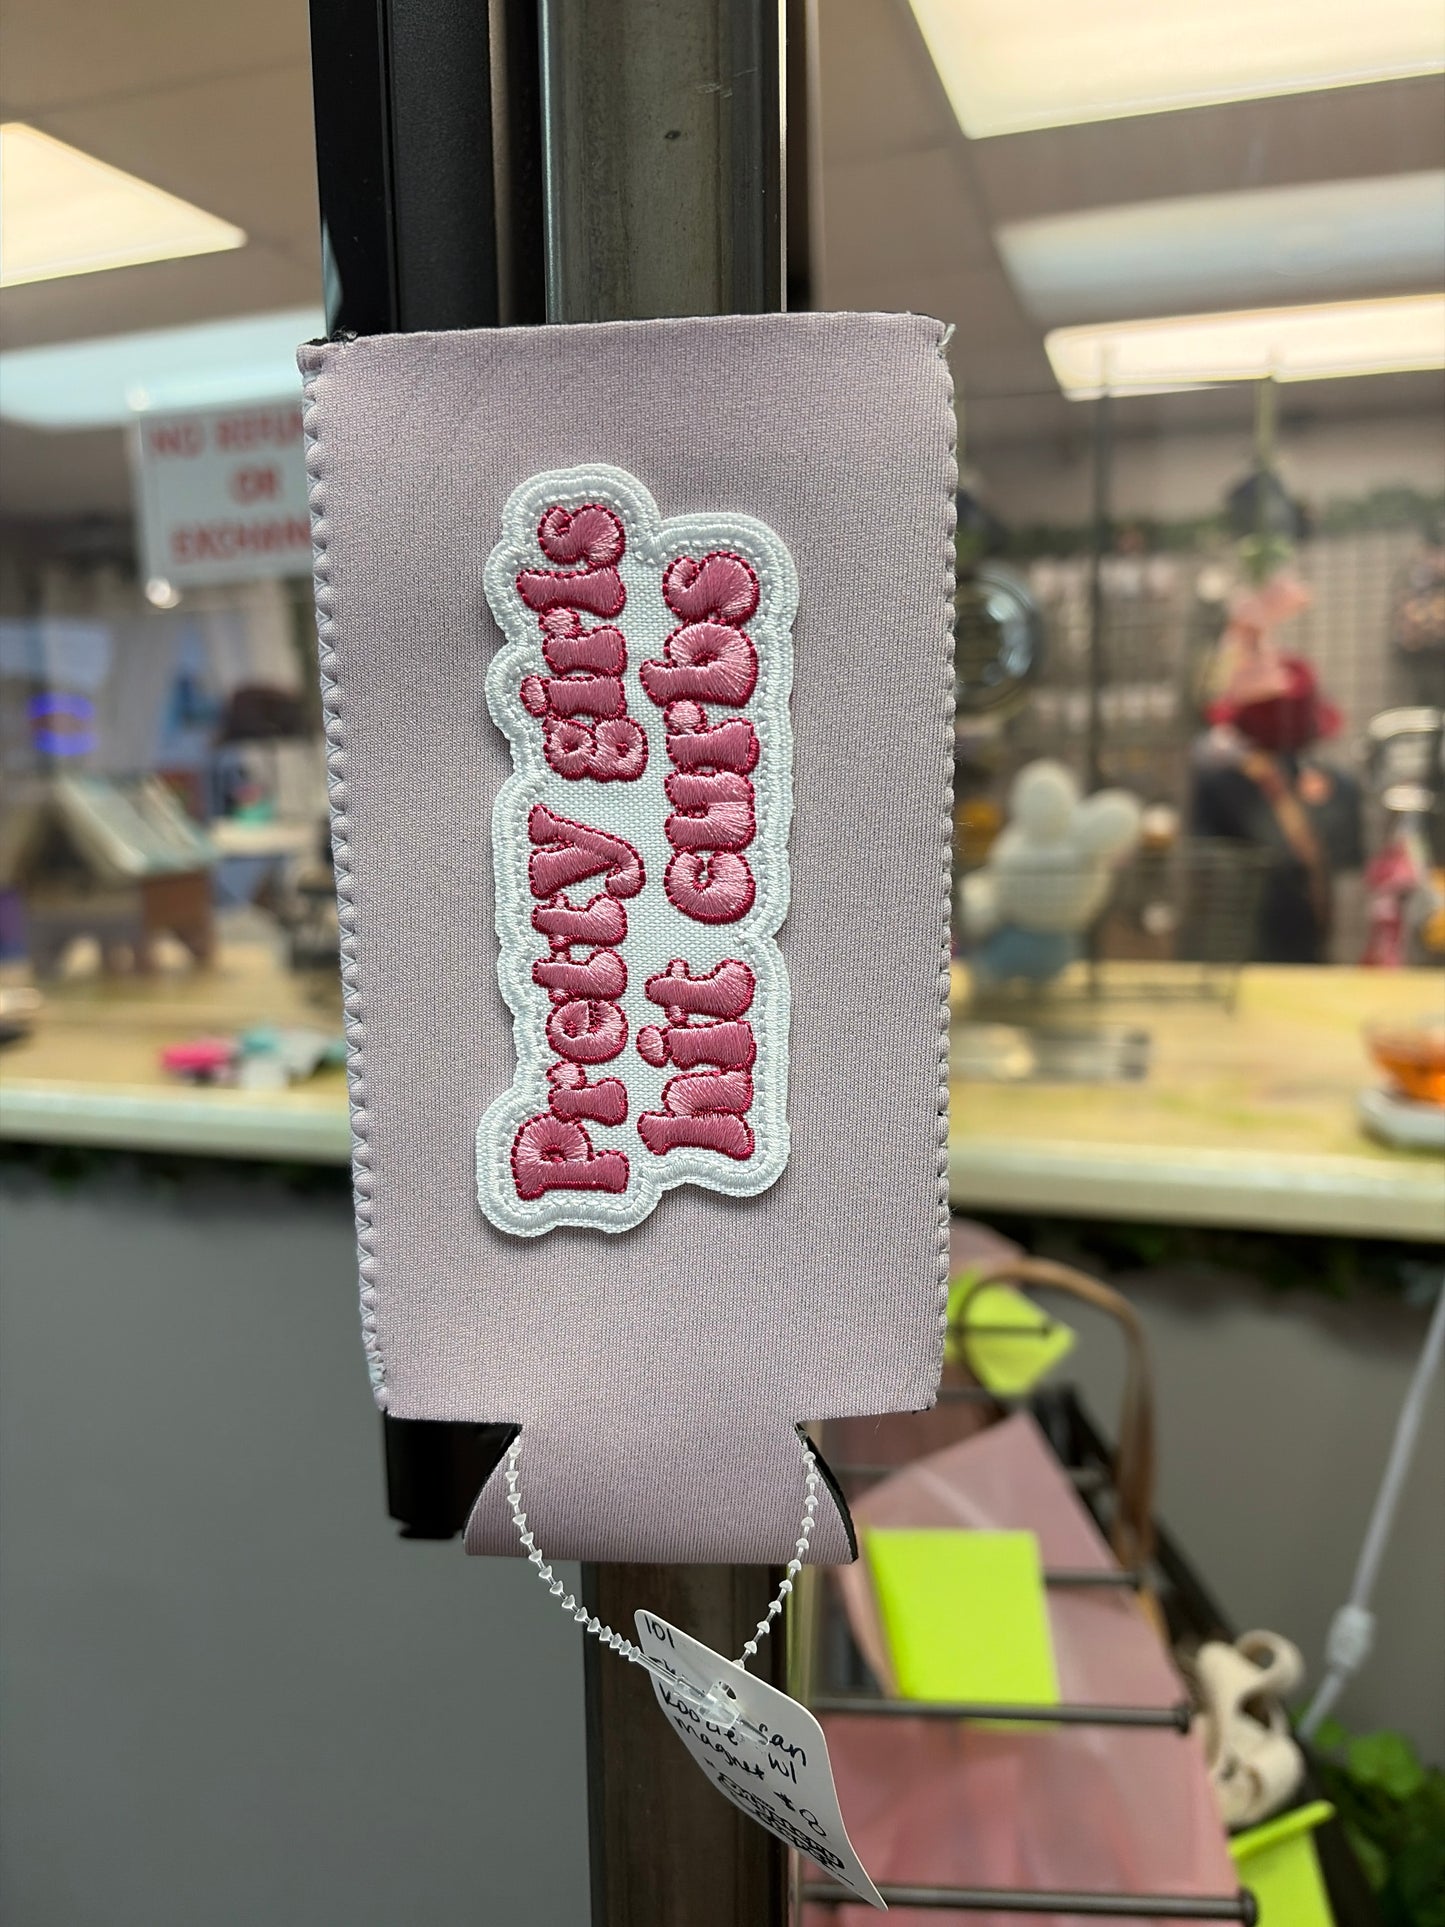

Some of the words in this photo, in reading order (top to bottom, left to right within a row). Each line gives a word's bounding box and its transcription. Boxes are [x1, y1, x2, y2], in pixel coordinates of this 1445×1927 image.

[150, 423, 203, 458] NO
[231, 468, 281, 504] OR
[515, 503, 649, 782] girls
[638, 550, 760, 926] curbs
[510, 804, 645, 1202] Pretty
[635, 956, 756, 1162] hit
[644, 1614, 674, 1648] 101
[674, 1716, 764, 1780] magnet
